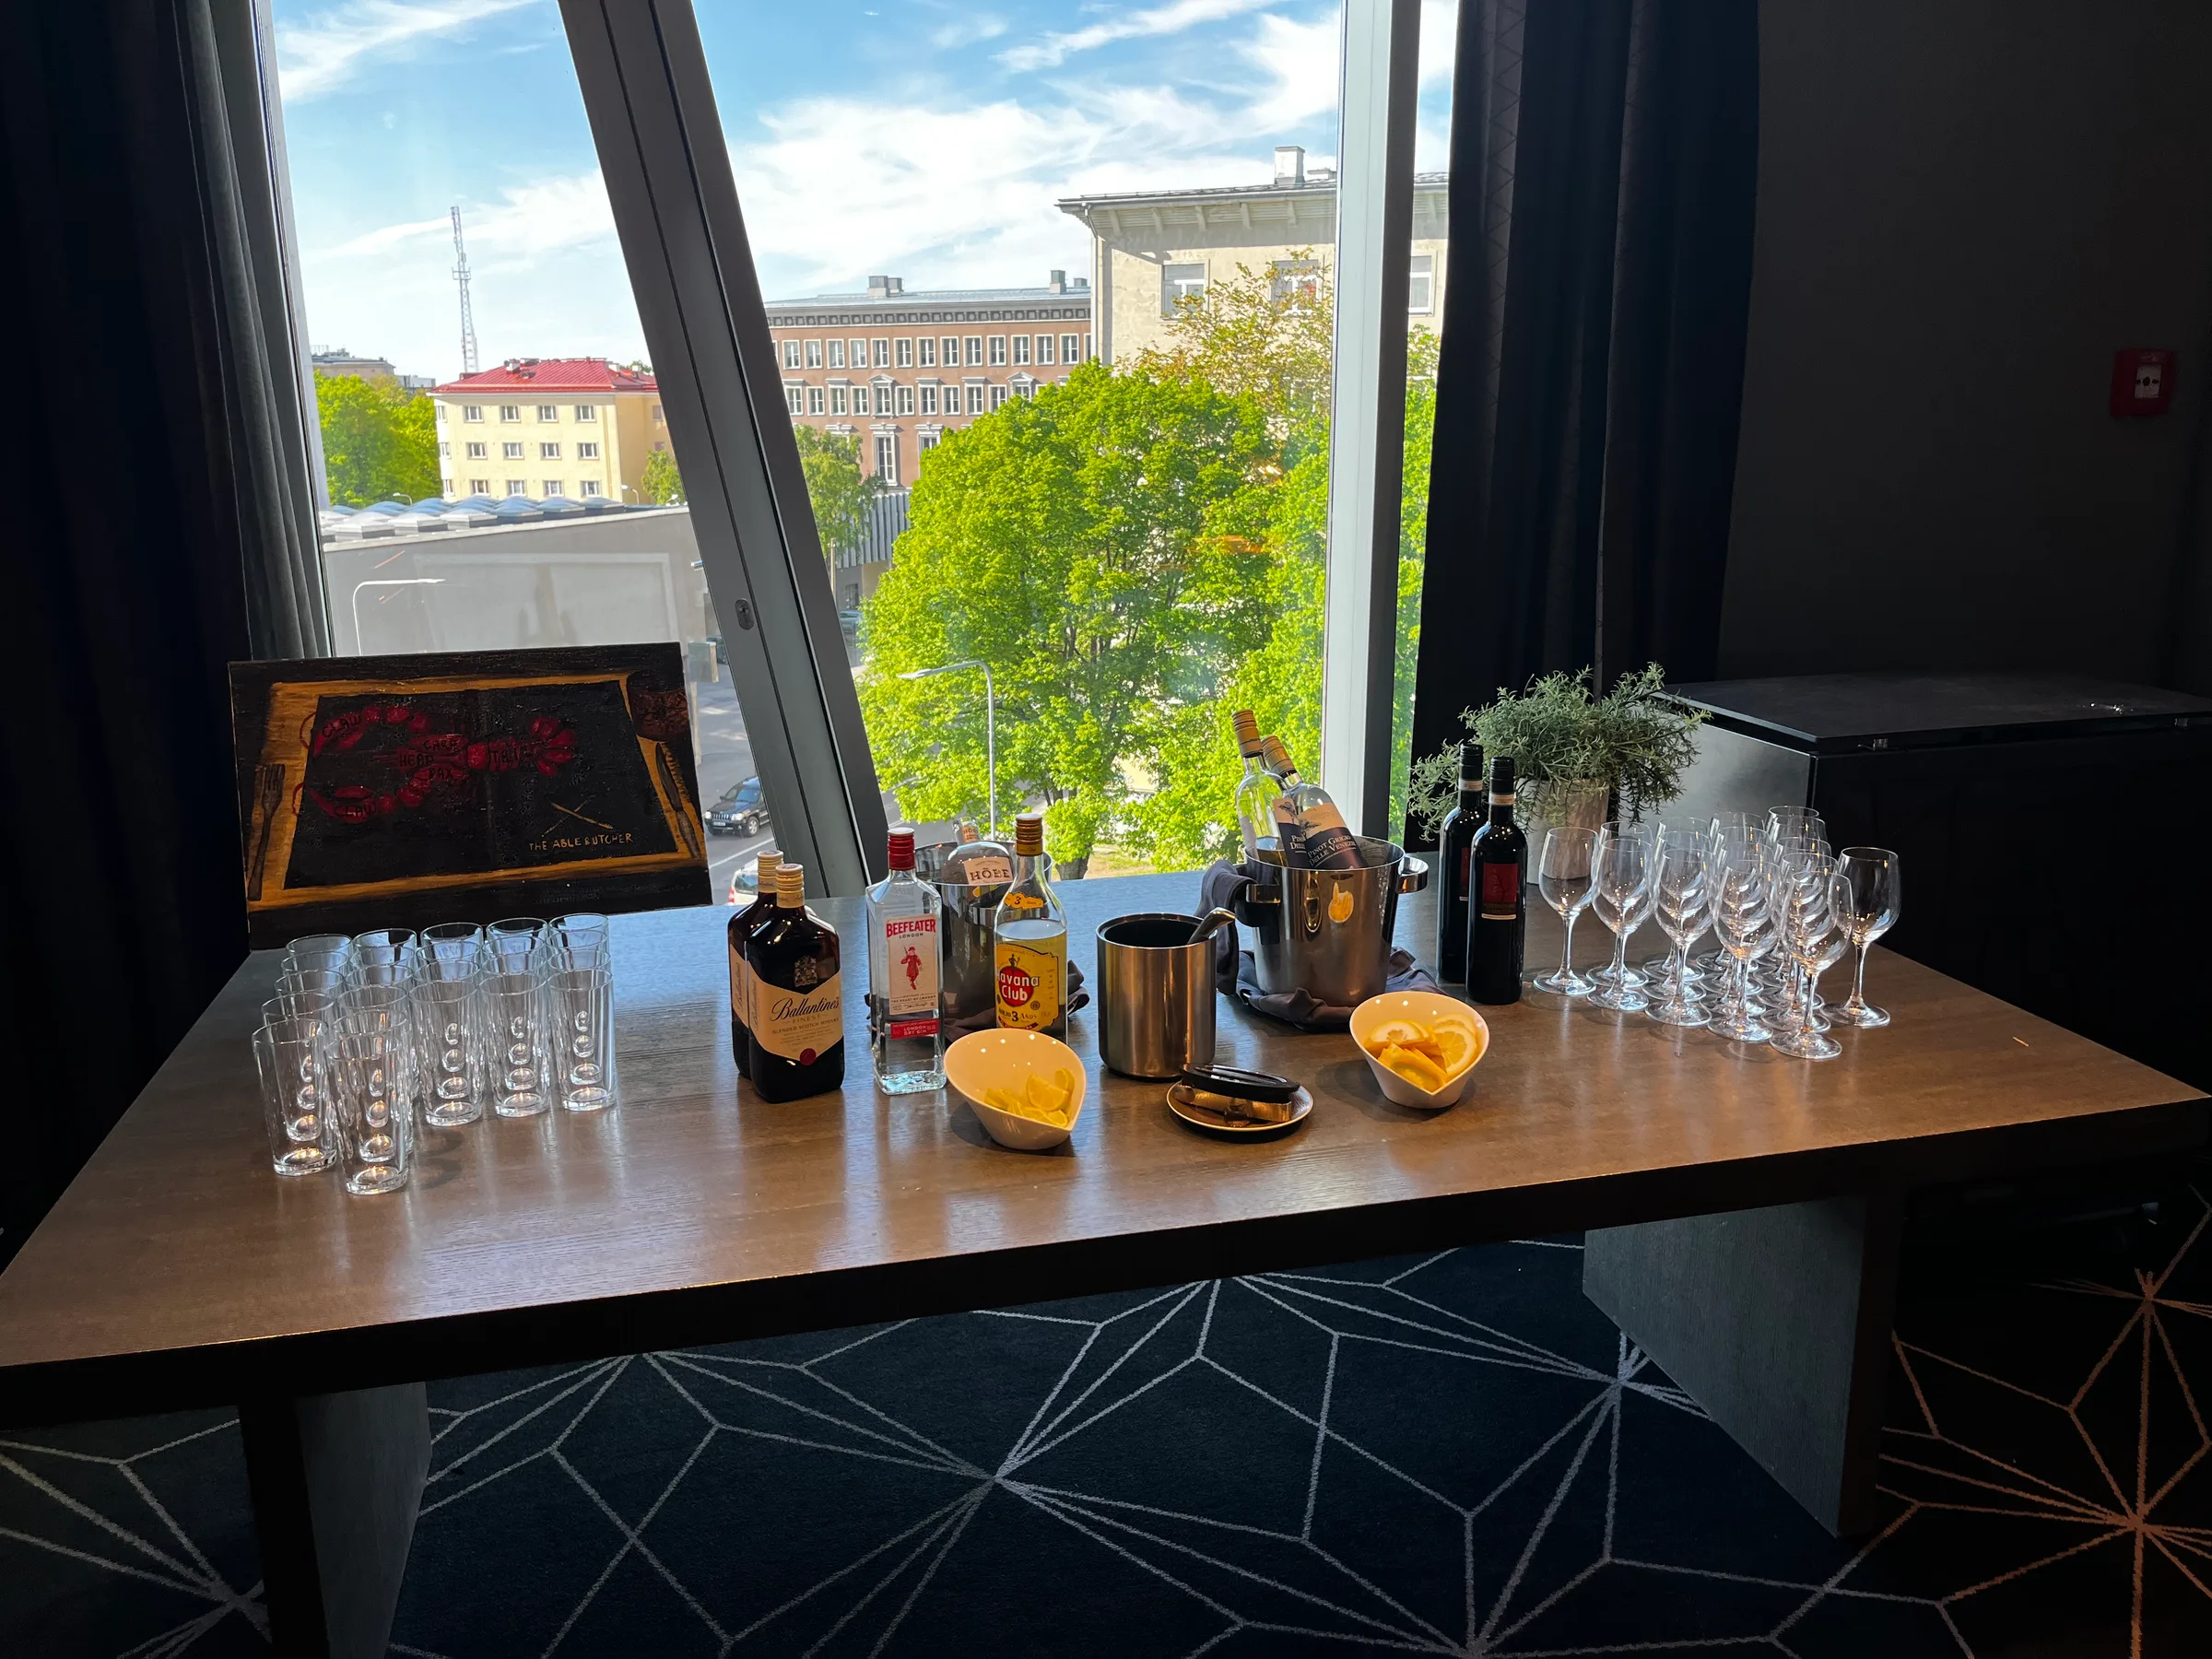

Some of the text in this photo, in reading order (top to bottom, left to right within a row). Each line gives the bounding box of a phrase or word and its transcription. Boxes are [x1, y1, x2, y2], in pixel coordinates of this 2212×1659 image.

[323, 715, 363, 737] CLAW
[335, 801, 377, 818] CLAW
[529, 832, 633, 851] THE ABLE BUTCHER
[1308, 835, 1351, 859] PINOT GRIGIO
[1309, 849, 1330, 866] DELLE
[1015, 896, 1021, 905] 3
[886, 919, 936, 938] BEEFEATER
[1001, 984, 1029, 1002] Club
[770, 996, 841, 1022] Ballantine's
[1012, 1010, 1019, 1022] 3
[793, 1014, 821, 1023] FINEST
